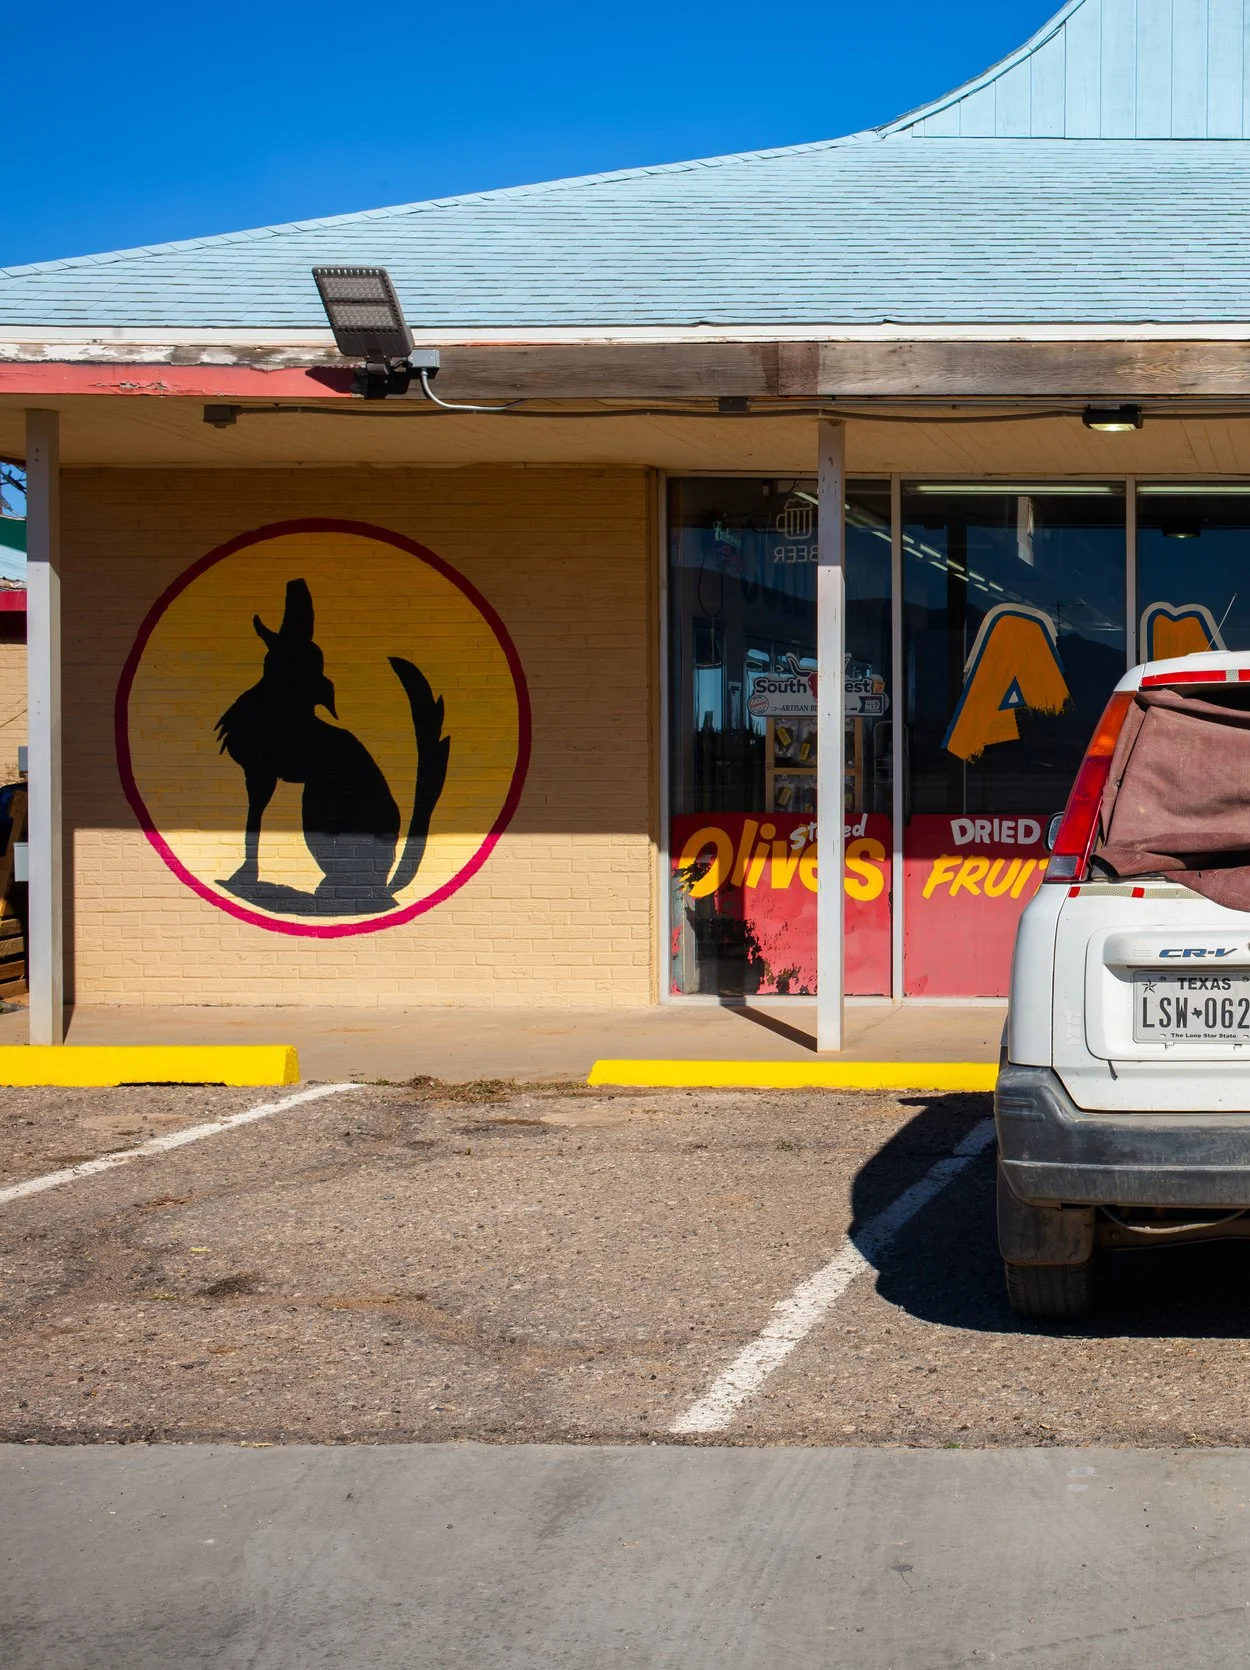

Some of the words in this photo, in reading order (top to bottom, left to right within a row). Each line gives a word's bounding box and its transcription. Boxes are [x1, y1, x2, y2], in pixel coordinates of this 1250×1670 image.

[755, 679, 807, 693] South
[845, 679, 872, 693] est
[789, 813, 868, 850] sted
[950, 818, 1041, 846] DRIED
[1159, 948, 1238, 957] CR-V
[1177, 977, 1231, 990] TEXAS
[1142, 997, 1188, 1028] LSW
